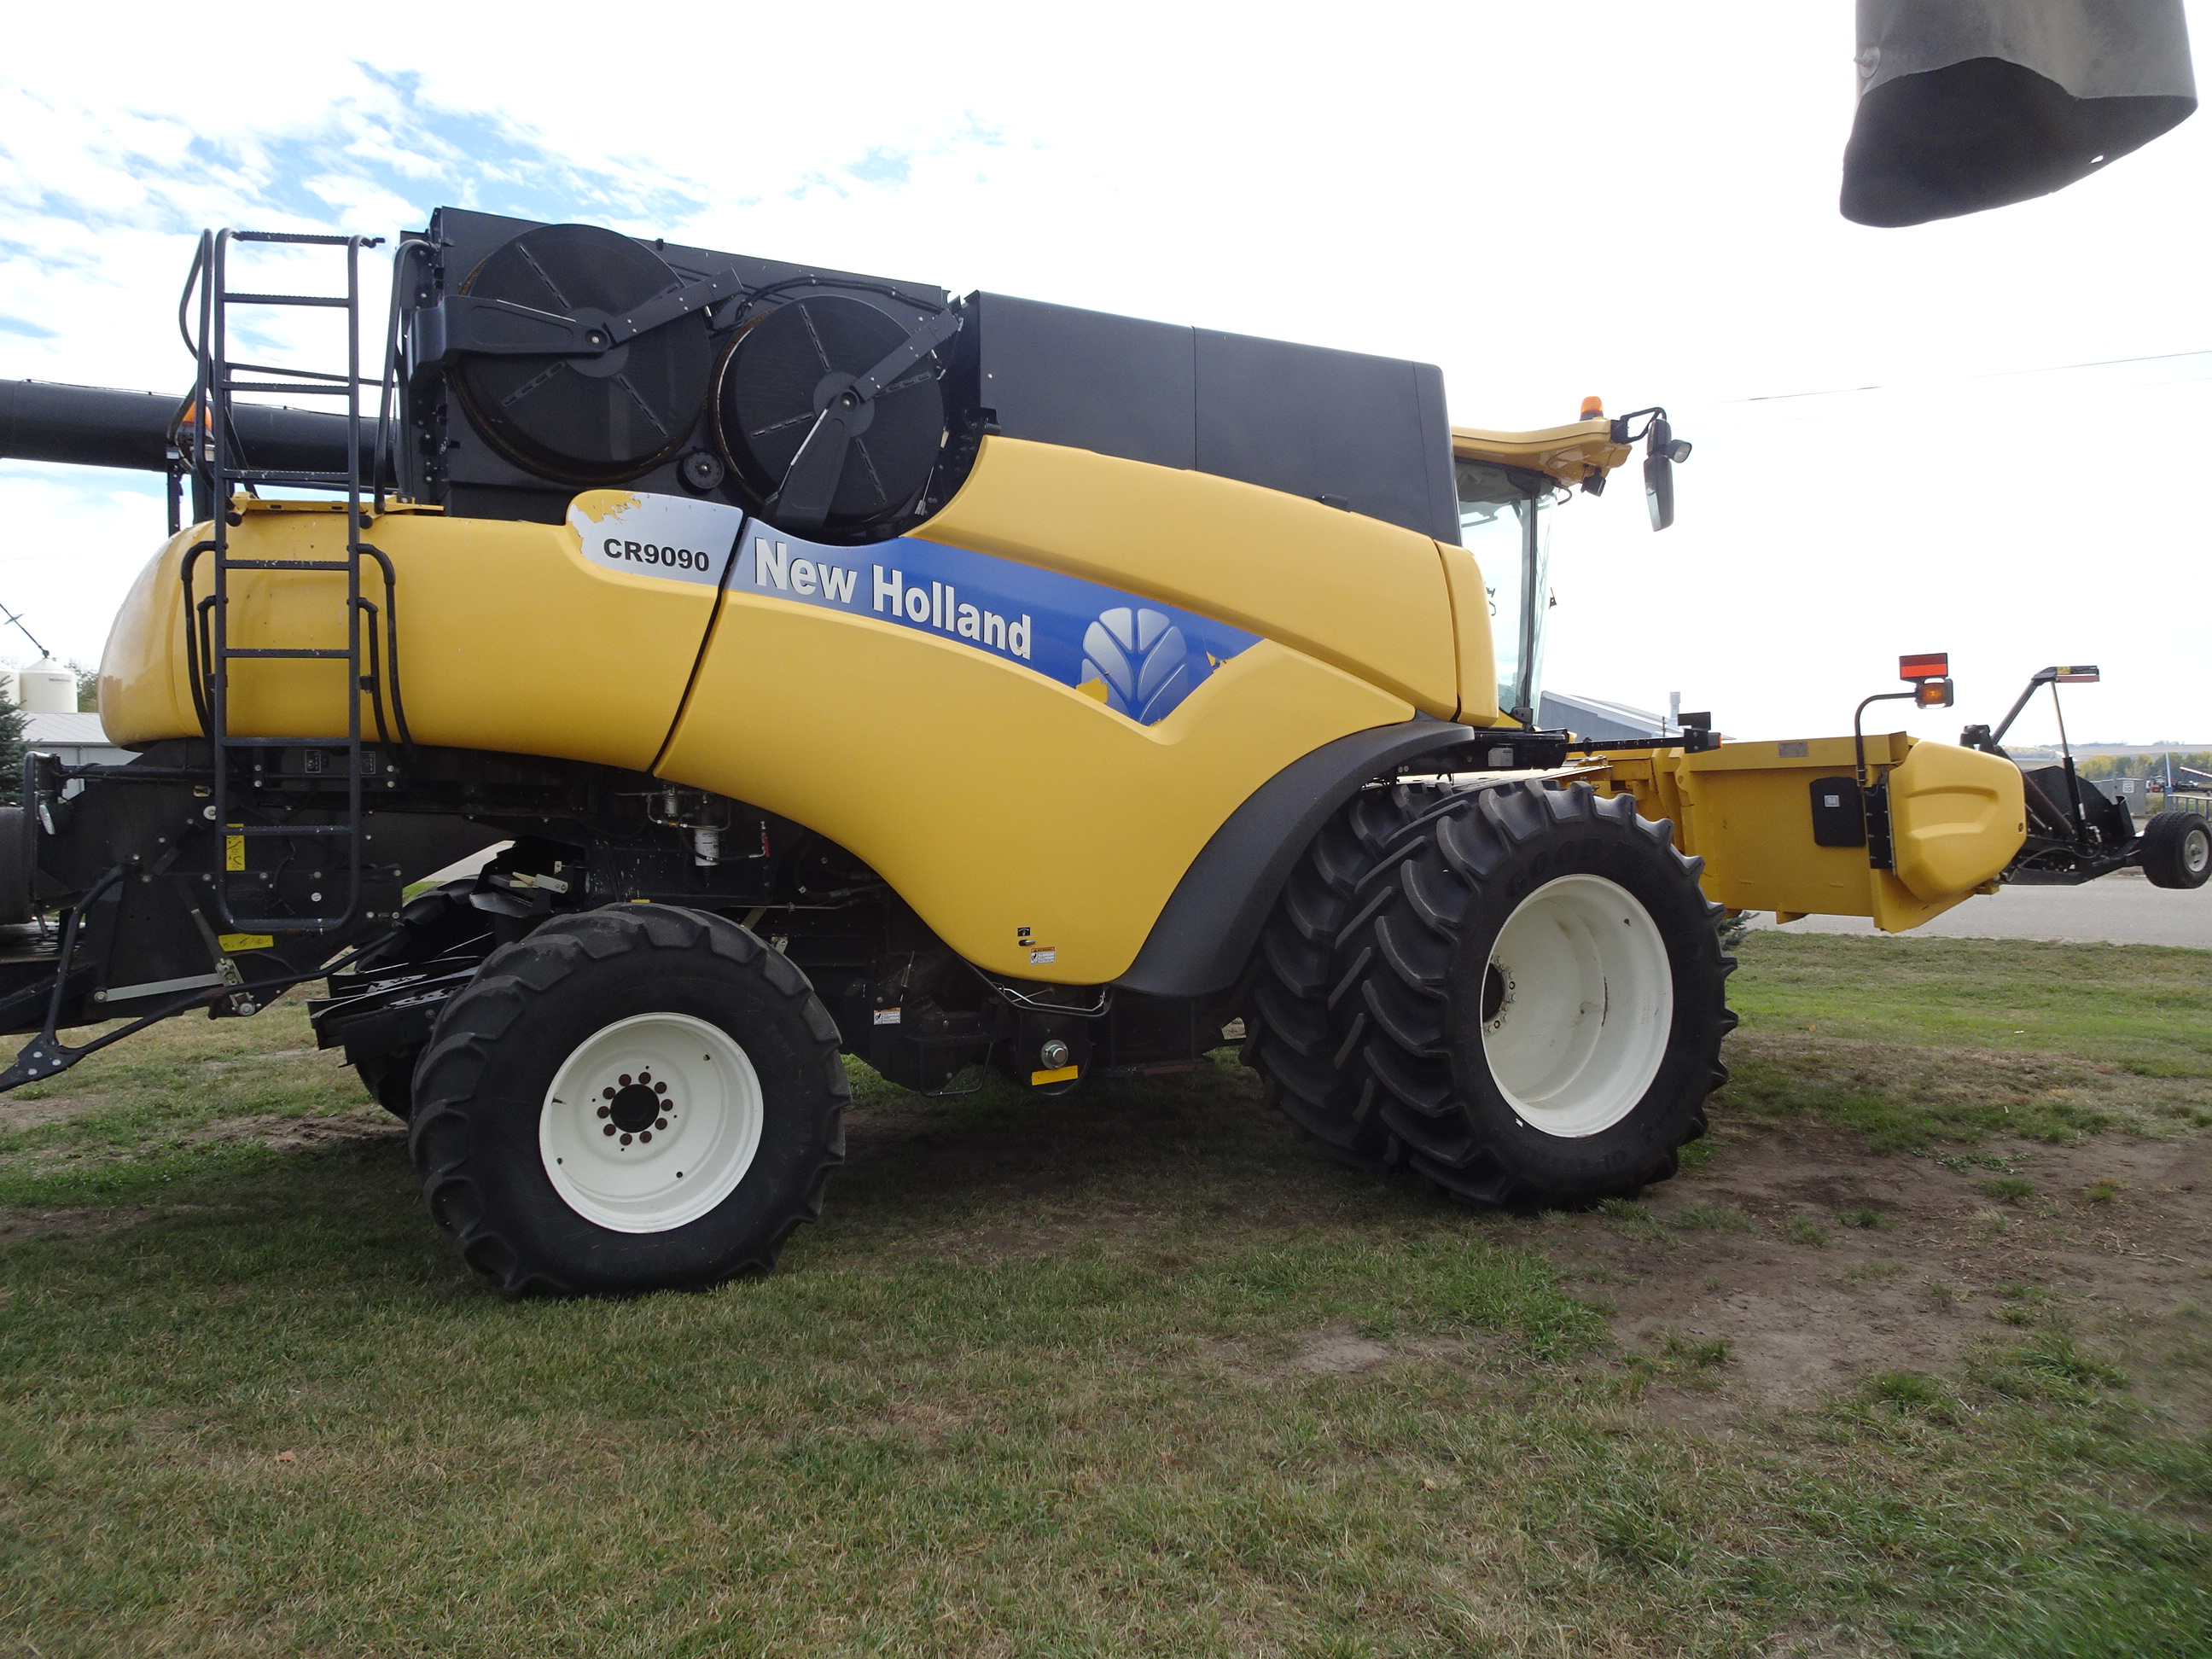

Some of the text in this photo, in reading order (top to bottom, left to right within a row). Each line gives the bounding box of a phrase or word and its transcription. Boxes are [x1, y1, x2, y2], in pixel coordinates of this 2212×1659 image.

[603, 538, 709, 572] CR9090
[754, 537, 1031, 661] New Holland
